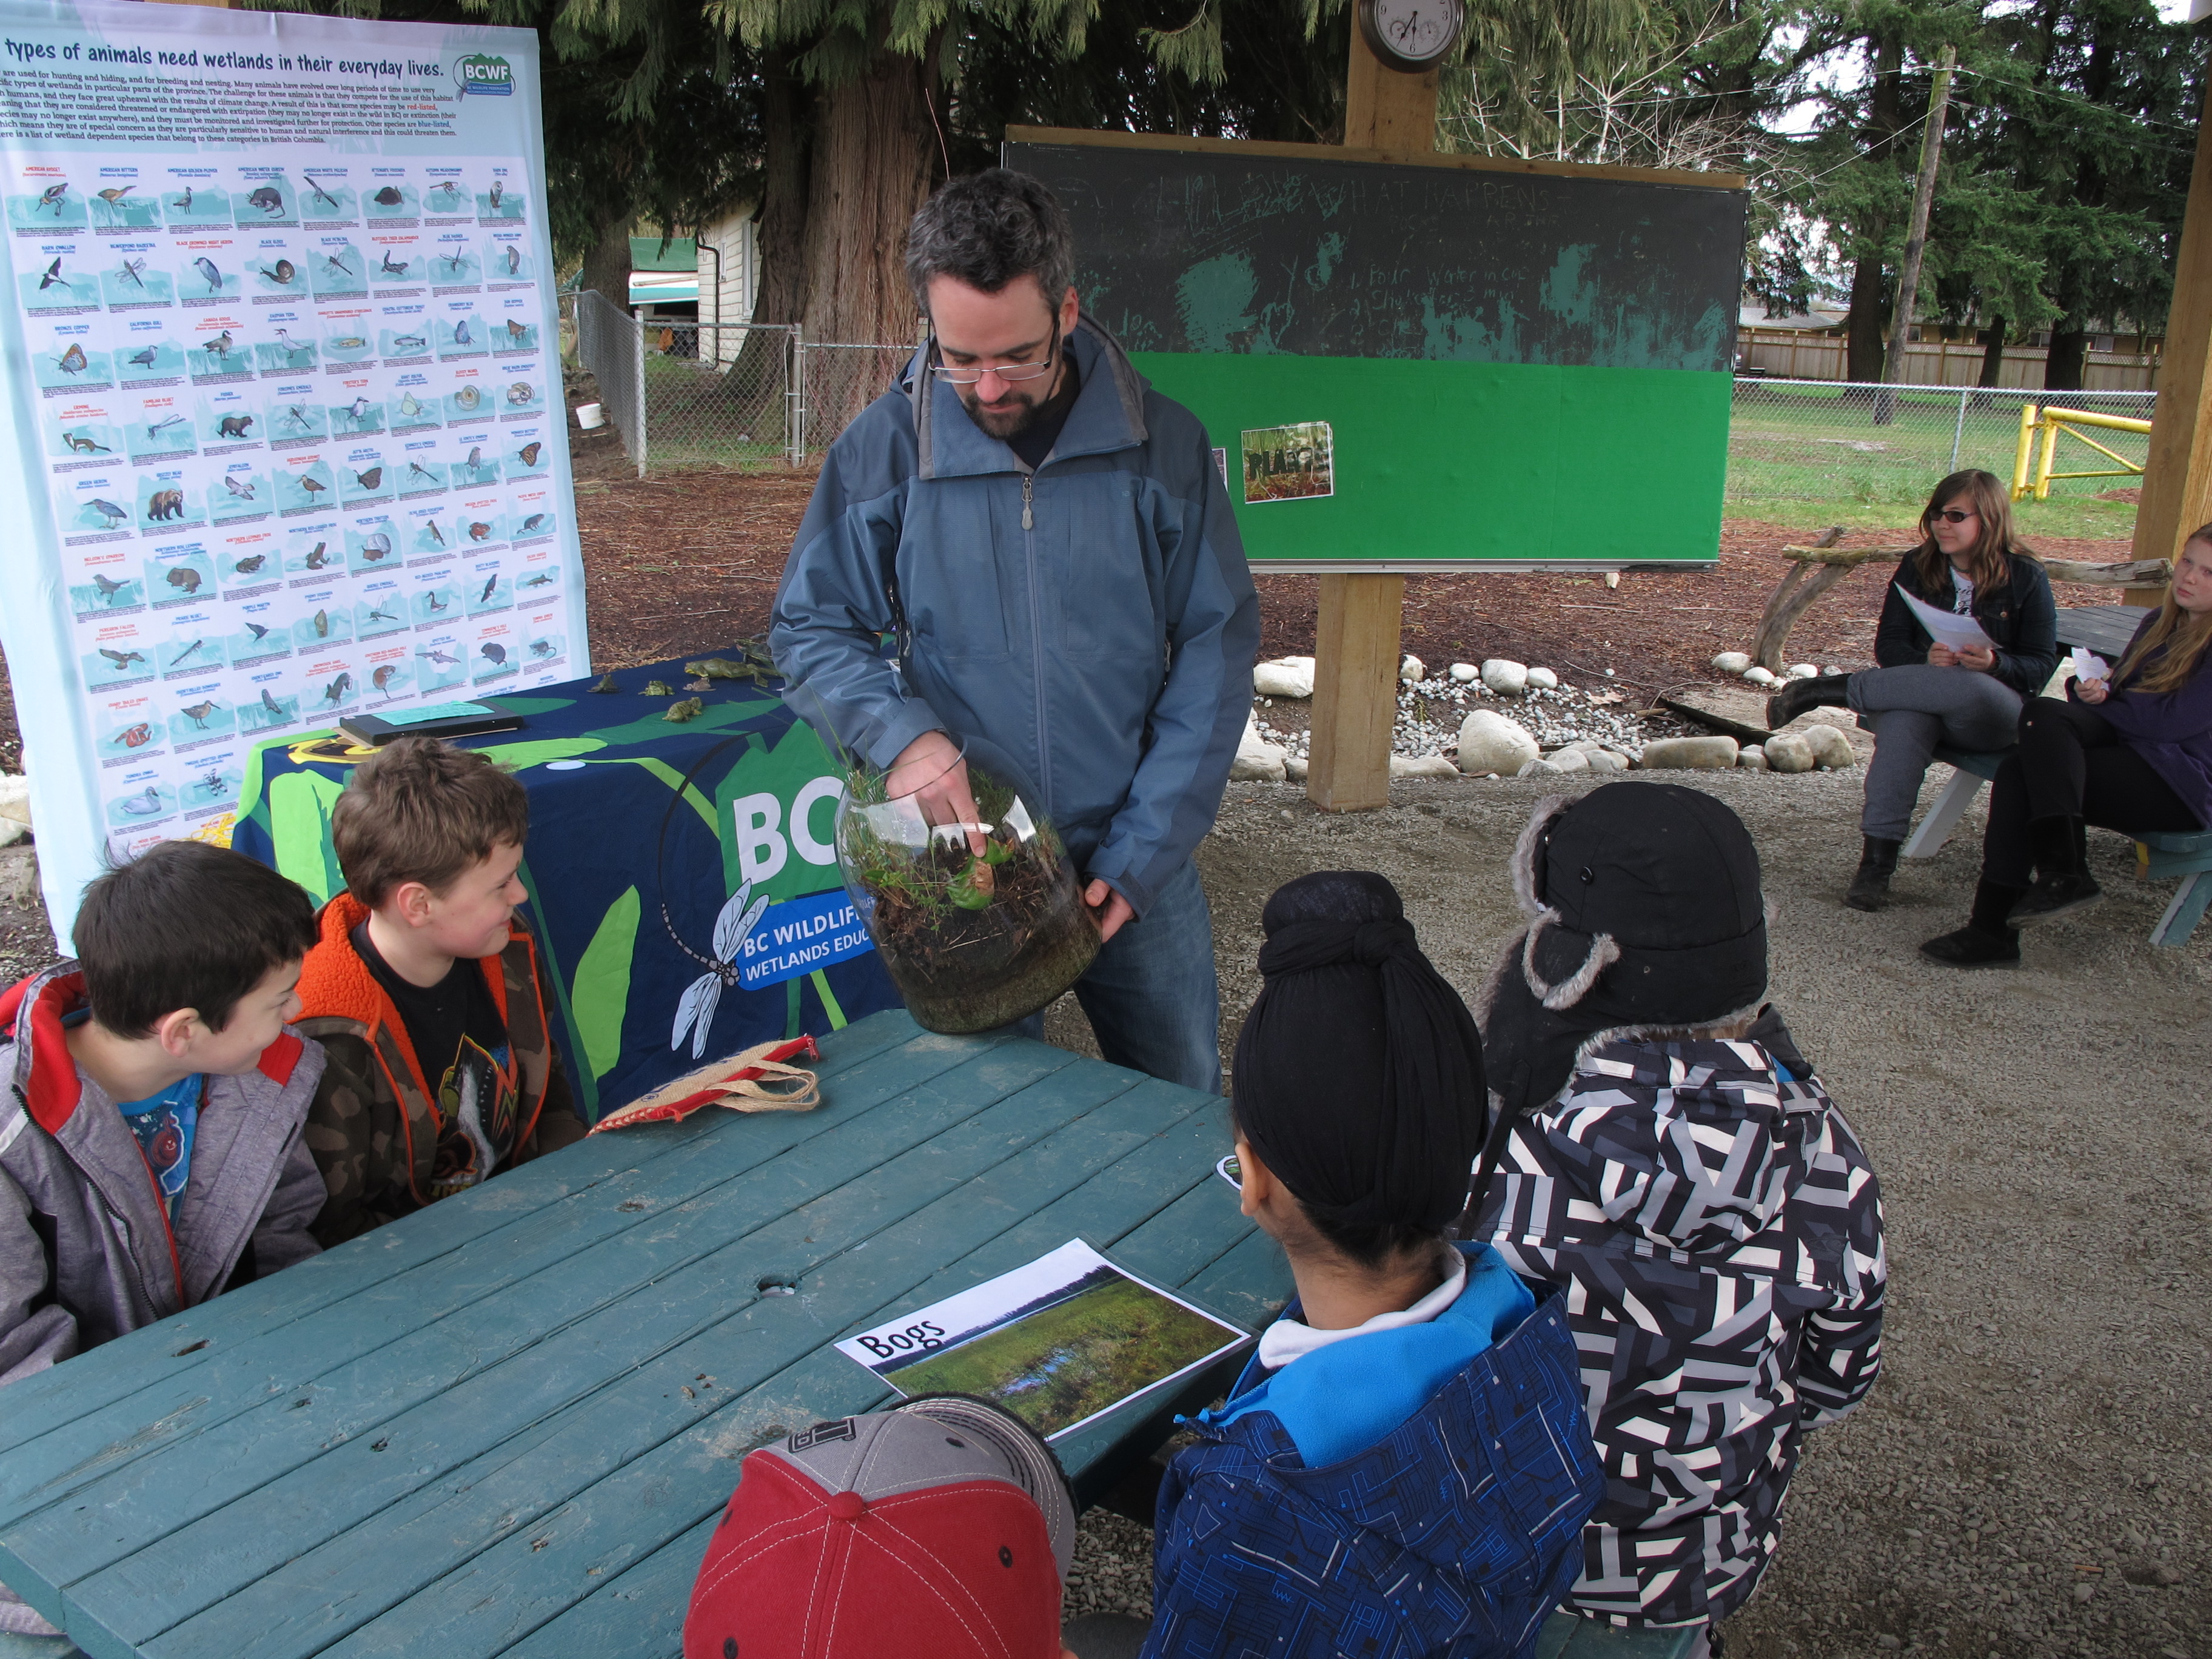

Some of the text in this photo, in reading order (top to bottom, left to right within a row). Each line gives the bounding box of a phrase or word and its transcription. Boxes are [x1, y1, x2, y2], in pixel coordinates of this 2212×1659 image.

[1381, 5, 1387, 15] 9
[1442, 11, 1448, 20] 3
[1410, 44, 1415, 53] 6
[5, 38, 444, 79] types of animals need wetlands in their everyday lives.
[465, 64, 508, 80] BCWF
[5, 89, 41, 99] humans,
[59, 92, 76, 101] they
[95, 94, 115, 102] great
[116, 95, 150, 104] upheaval
[217, 98, 243, 106] climate
[244, 99, 270, 108] change.
[359, 102, 382, 111] species
[406, 103, 438, 112] red-listed,
[47, 121, 63, 131] they
[89, 123, 115, 132] special
[158, 124, 172, 134] they
[188, 126, 227, 135] particularly
[52, 112, 76, 121] longer
[99, 114, 139, 124] anywhere),
[156, 115, 172, 124] they
[256, 118, 295, 127] investigated
[331, 119, 364, 128] protection.
[384, 120, 405, 129] species
[418, 121, 451, 130] blue-listed,
[87, 132, 126, 141] dependent
[128, 133, 154, 142] species
[172, 134, 196, 143] belong
[227, 135, 260, 144] categories
[733, 776, 844, 885] BC
[744, 936, 768, 958] BC
[746, 941, 830, 981] WETLANDS
[856, 1319, 946, 1359] Bogs
